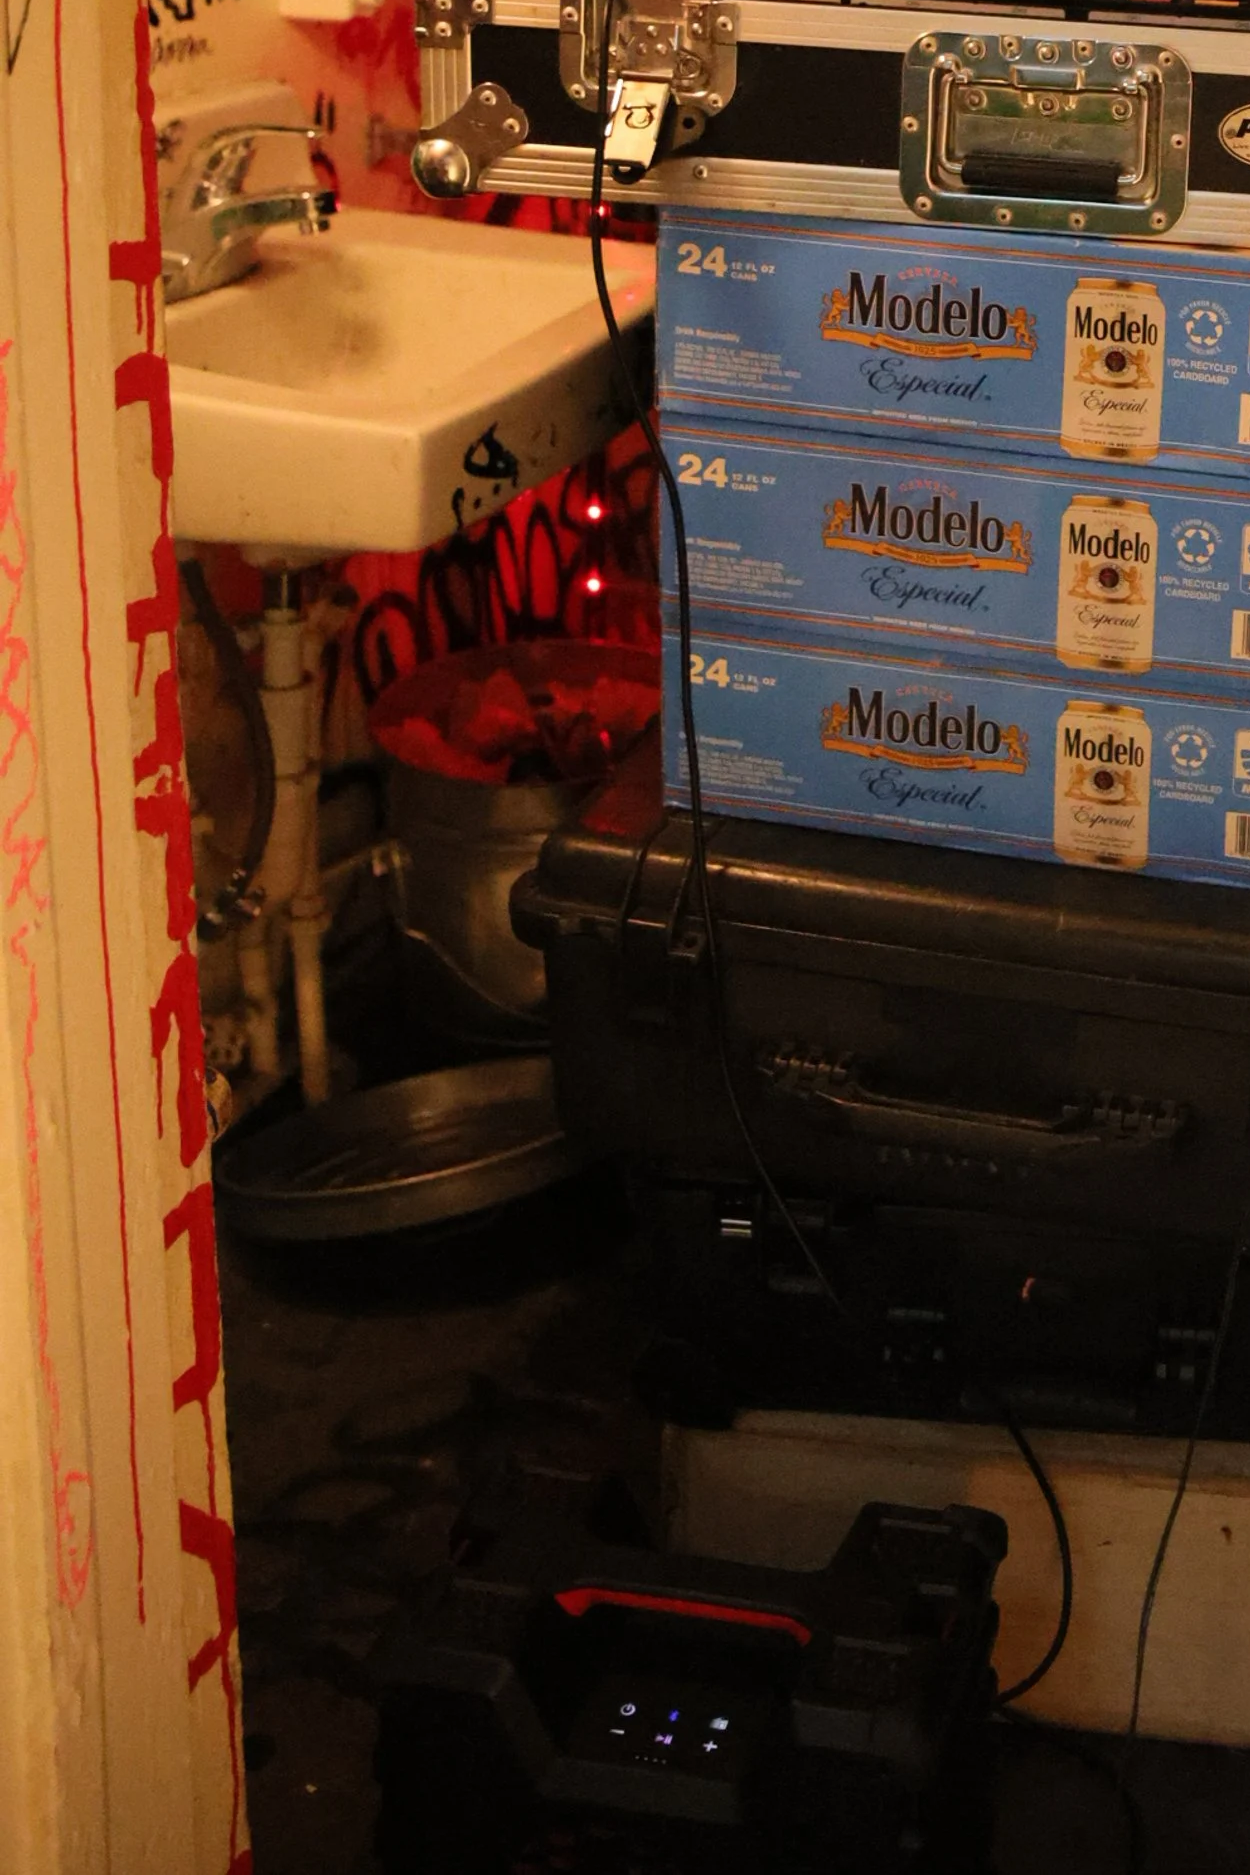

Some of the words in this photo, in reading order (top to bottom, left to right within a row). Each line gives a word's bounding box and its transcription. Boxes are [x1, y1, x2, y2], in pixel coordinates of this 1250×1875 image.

[677, 243, 728, 277] 24
[848, 272, 1008, 340] Modelo
[1074, 306, 1158, 346] Modelo
[860, 357, 987, 402] Especial
[1190, 360, 1237, 374] RECYCLED
[678, 453, 728, 488] 24
[850, 483, 1005, 553] Modelo
[1069, 522, 1150, 564] Modelo
[860, 565, 986, 611] Especial
[690, 653, 730, 688] 24
[848, 687, 1001, 754] Modelo
[1064, 727, 1144, 768] Modelo
[858, 767, 983, 811] Especial
